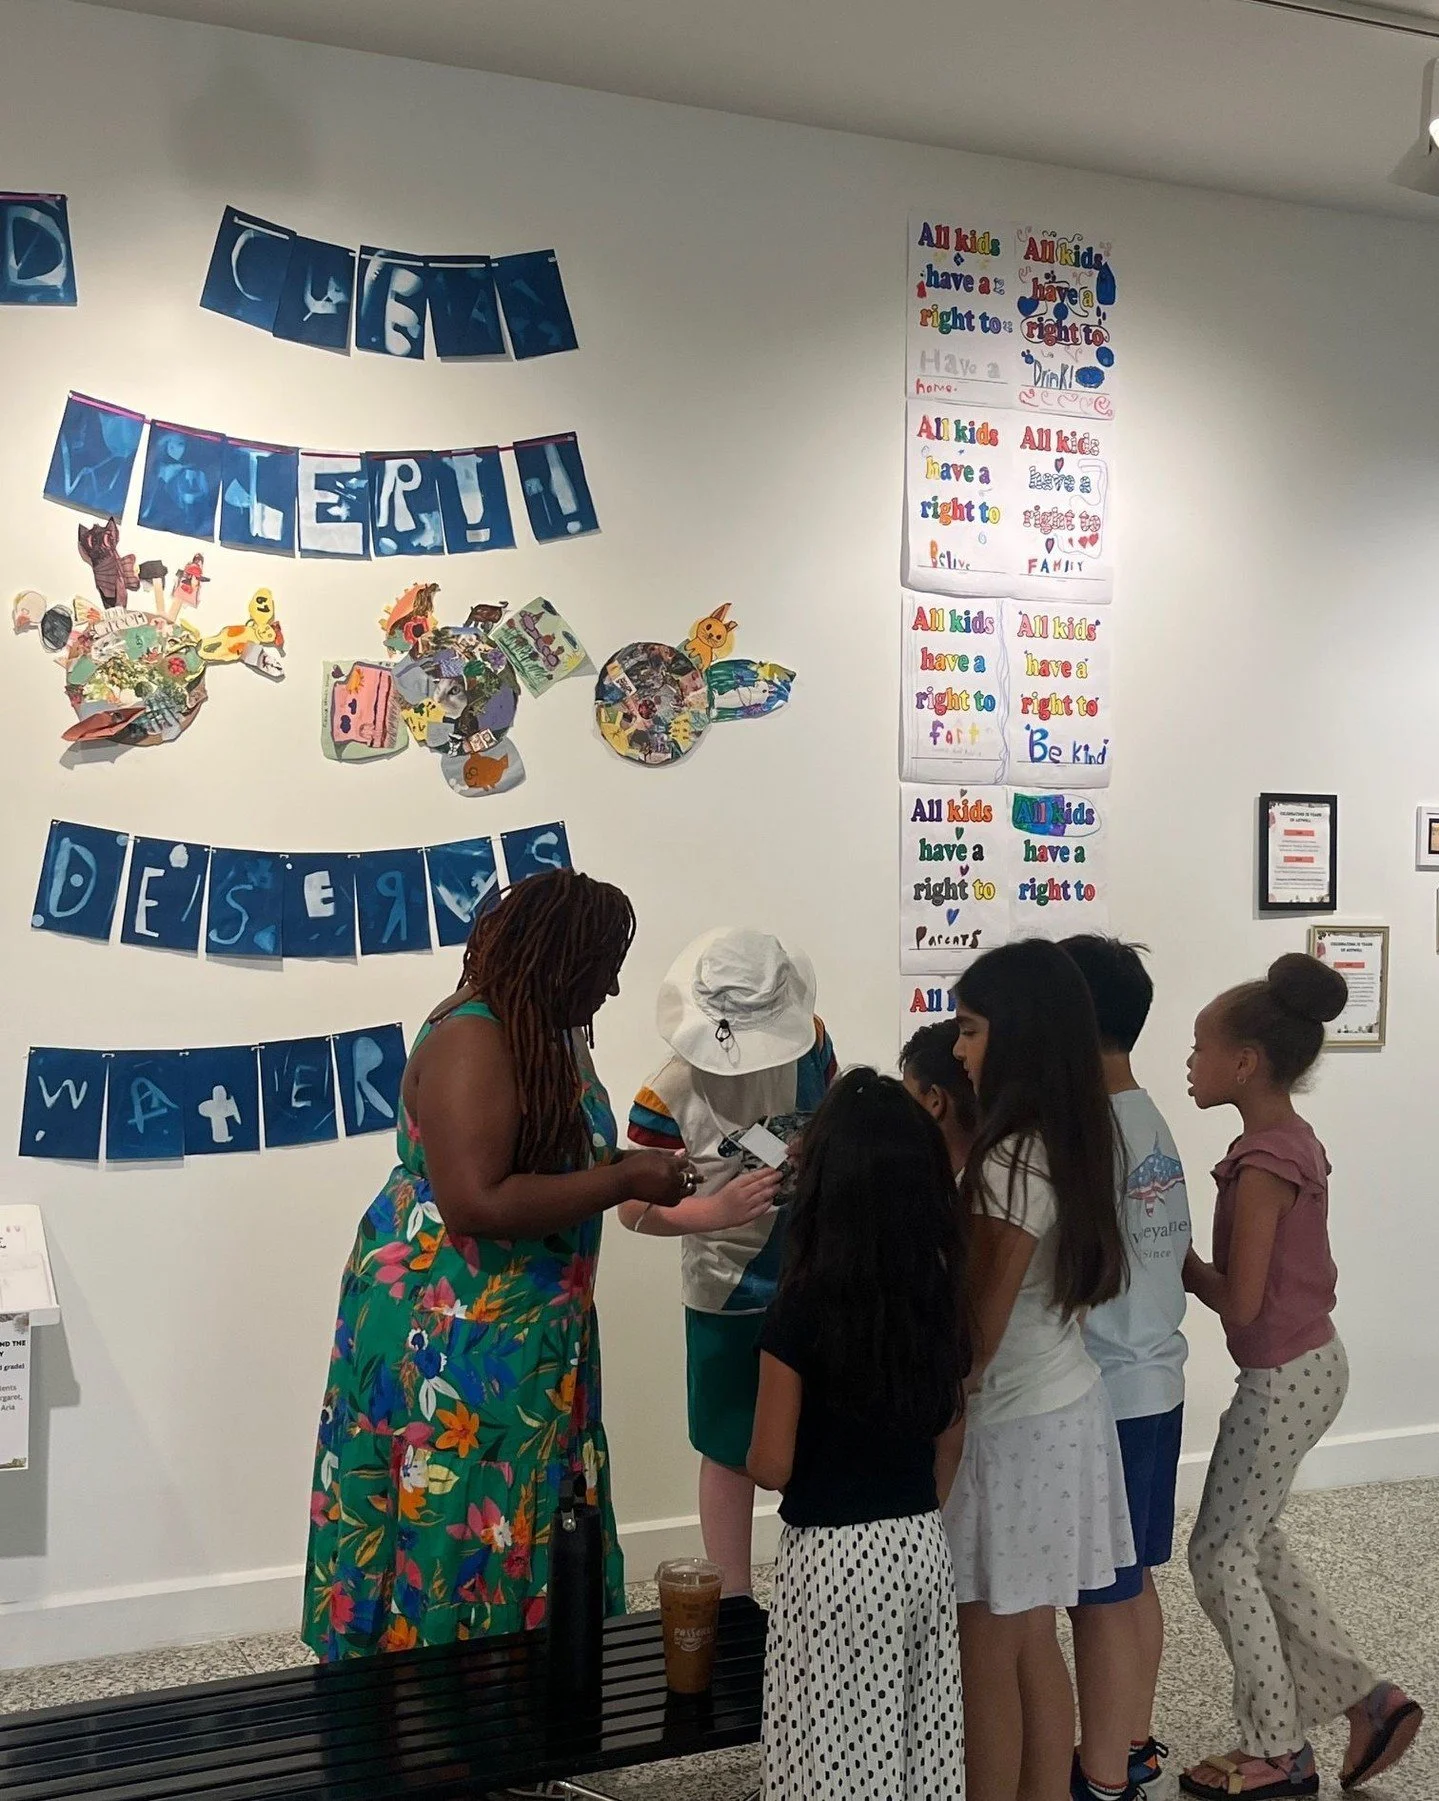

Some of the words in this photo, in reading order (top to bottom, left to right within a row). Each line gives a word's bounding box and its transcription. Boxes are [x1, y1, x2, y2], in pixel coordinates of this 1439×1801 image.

[918, 222, 949, 250] All
[954, 228, 1000, 256] kids
[1024, 237, 1054, 263] All
[1059, 243, 1103, 271] kids
[926, 264, 974, 293] have
[979, 277, 991, 294] a
[1032, 277, 1077, 304] have
[1082, 289, 1094, 308] a
[920, 304, 975, 335] right
[979, 310, 1000, 334] to
[1026, 317, 1079, 346] right
[1083, 325, 1104, 346] to
[920, 350, 976, 377] Have
[987, 362, 1000, 378] a
[917, 415, 950, 441] All
[954, 419, 999, 447] kids
[1020, 426, 1051, 451] All
[1056, 430, 1100, 456] kids
[926, 456, 974, 483] have
[979, 466, 991, 484] a
[1029, 466, 1075, 492] have
[1079, 476, 1091, 493] a
[920, 495, 975, 526] right
[979, 501, 1000, 525] to
[1023, 505, 1075, 535] right
[1080, 511, 1101, 532] to
[912, 607, 944, 631] All
[949, 609, 994, 634] kids
[1017, 613, 1048, 638] All
[1053, 616, 1096, 641] kids
[920, 647, 969, 672] have
[974, 655, 986, 673] a
[1026, 652, 1071, 678] have
[1076, 661, 1088, 678] a
[916, 686, 970, 715] right
[974, 690, 996, 712] to
[1021, 692, 1073, 720] right
[1077, 695, 1098, 717] to
[1029, 728, 1062, 763] Be
[1072, 741, 1107, 764] kind
[911, 798, 942, 822] All
[947, 799, 993, 822] kids
[1016, 803, 1046, 824] All
[1052, 802, 1095, 825] kids
[919, 838, 967, 862] have
[972, 844, 984, 861] a
[1024, 839, 1070, 863] have
[1074, 845, 1086, 863] a
[914, 877, 968, 906] right
[972, 879, 996, 900] to
[1019, 877, 1071, 906] right
[1074, 880, 1096, 901] to
[910, 988, 942, 1012] All
[13, 1339, 26, 1347] THE
